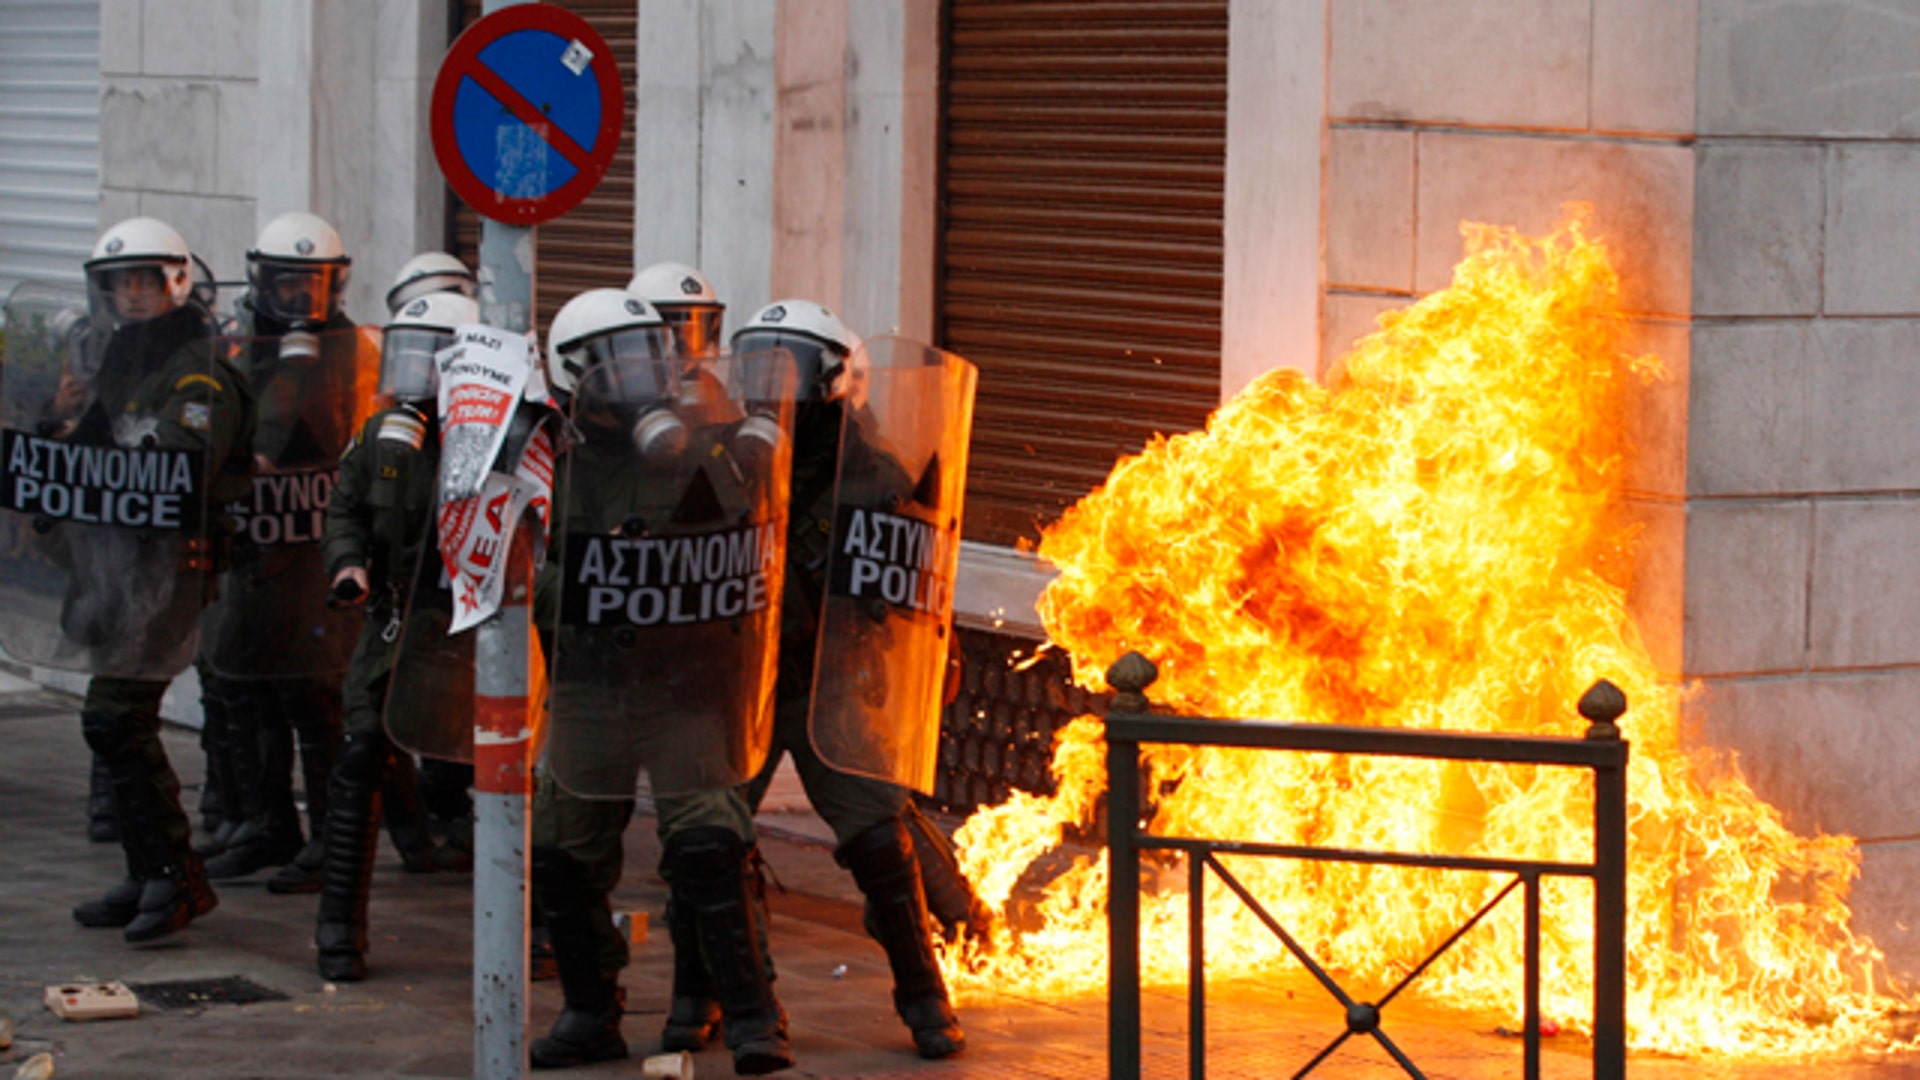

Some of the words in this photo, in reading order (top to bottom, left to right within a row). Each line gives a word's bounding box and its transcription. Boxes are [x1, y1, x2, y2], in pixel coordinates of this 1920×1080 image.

[9, 434, 193, 493] ΑΣΤΥΝΟΜΙΑ
[14, 476, 182, 528] POLICE
[578, 522, 775, 586] ΑΣΤΥΝΟΜΙΑ
[587, 572, 768, 626] POLICE
